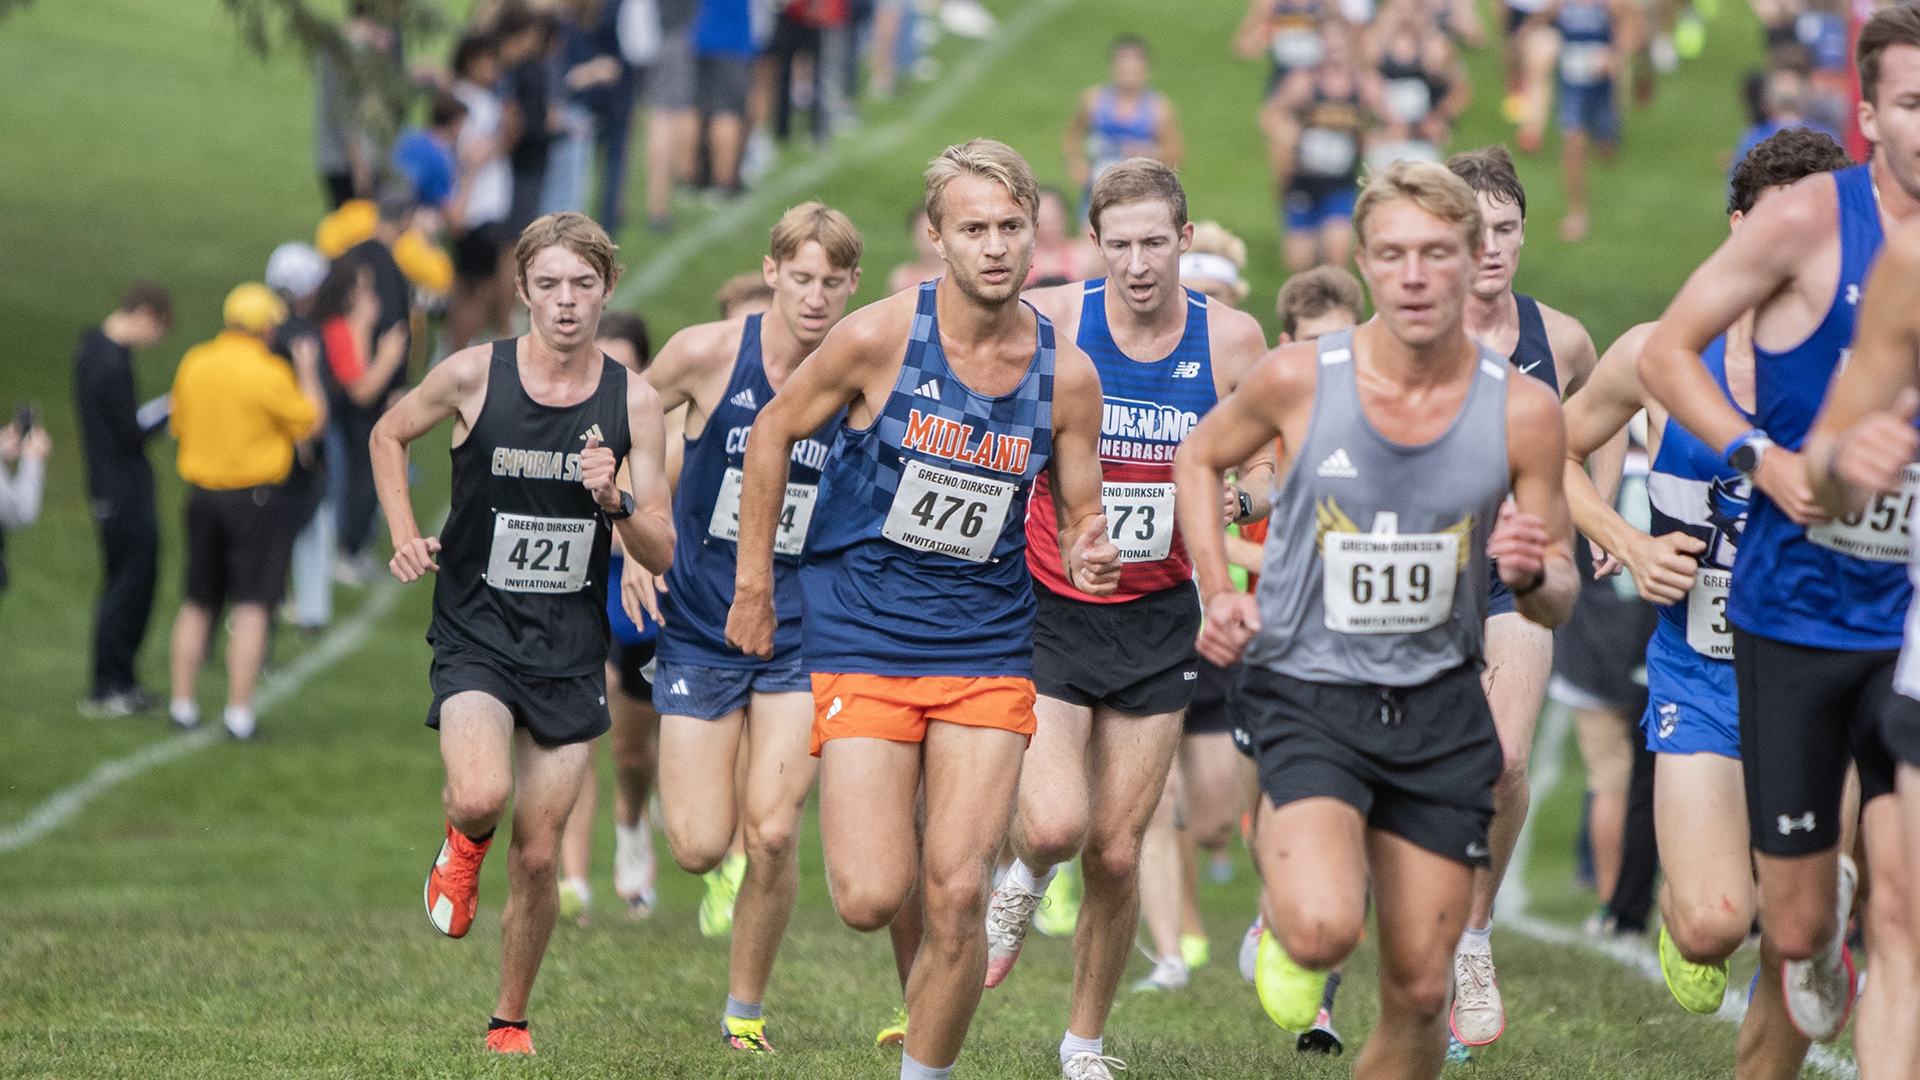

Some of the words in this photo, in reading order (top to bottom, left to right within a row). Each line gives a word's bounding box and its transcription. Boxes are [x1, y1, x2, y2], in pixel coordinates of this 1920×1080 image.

[1101, 403, 1198, 442] UNNING
[901, 408, 1032, 475] MIDLAND
[1100, 438, 1180, 461] NEBRASK
[491, 446, 563, 481] EMPORIA
[917, 468, 1003, 497] GREENO/DIRKSEN
[1102, 486, 1165, 498] ENO/DIRKSEN
[507, 519, 585, 533] GREENO/DIRKSEN
[910, 490, 988, 539] 476
[1103, 505, 1155, 541] 73
[508, 537, 571, 573] 421
[901, 532, 971, 557] INVITATIONAL
[1119, 549, 1152, 558] TIONAL
[504, 577, 568, 590] INVITATIONAL
[1351, 563, 1430, 605] 619
